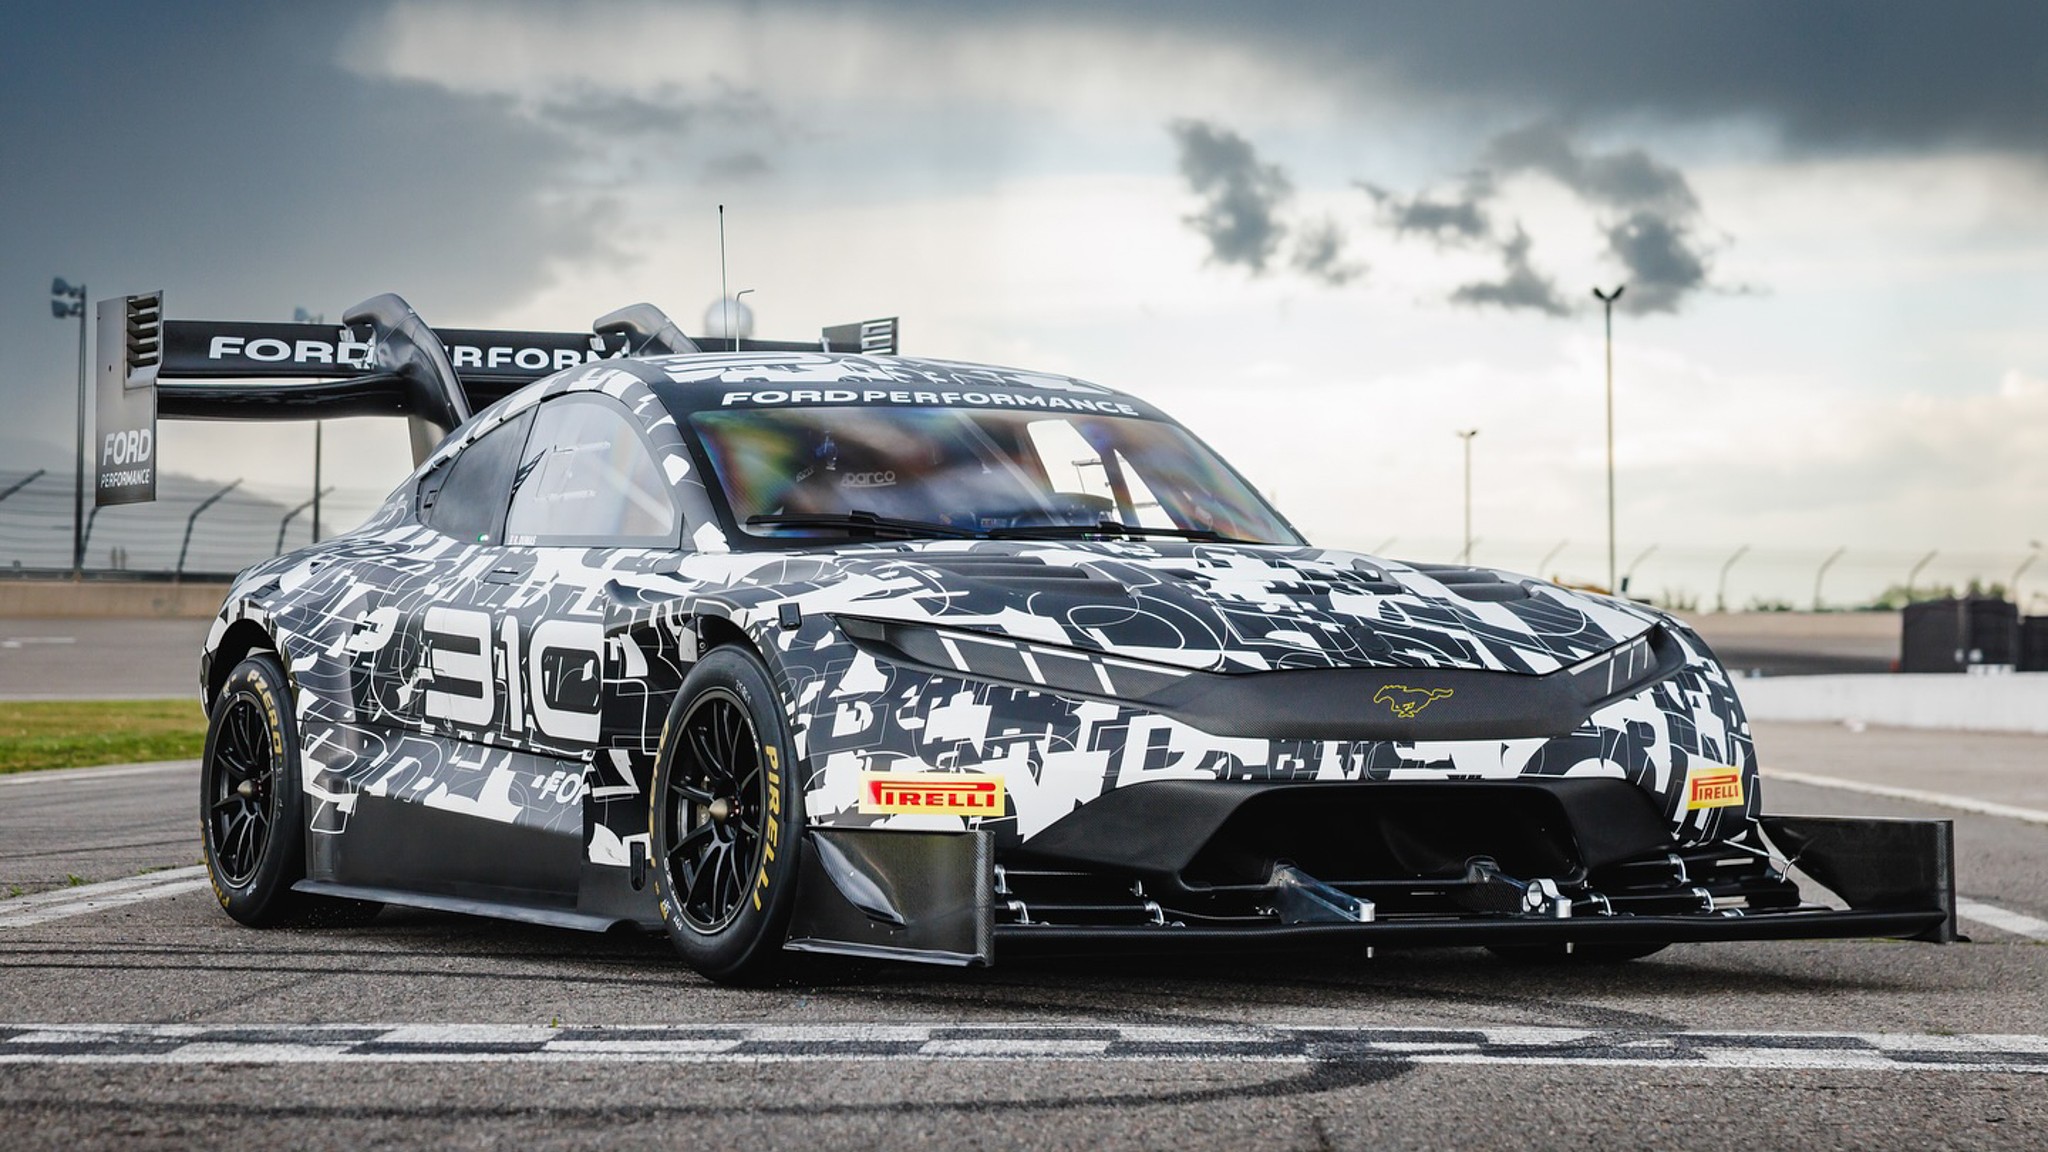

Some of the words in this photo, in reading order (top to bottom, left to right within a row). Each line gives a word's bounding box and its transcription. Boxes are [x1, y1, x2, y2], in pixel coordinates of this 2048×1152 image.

[209, 336, 376, 364] FORD
[722, 390, 858, 406] FORD
[863, 390, 1138, 416] PERFORMANCE
[102, 428, 152, 466] FORD
[100, 468, 150, 488] PERFORMANCE
[868, 780, 997, 807] PIRELLI
[1691, 774, 1739, 802] PIRELLI
[753, 744, 781, 912] PIRELLI
